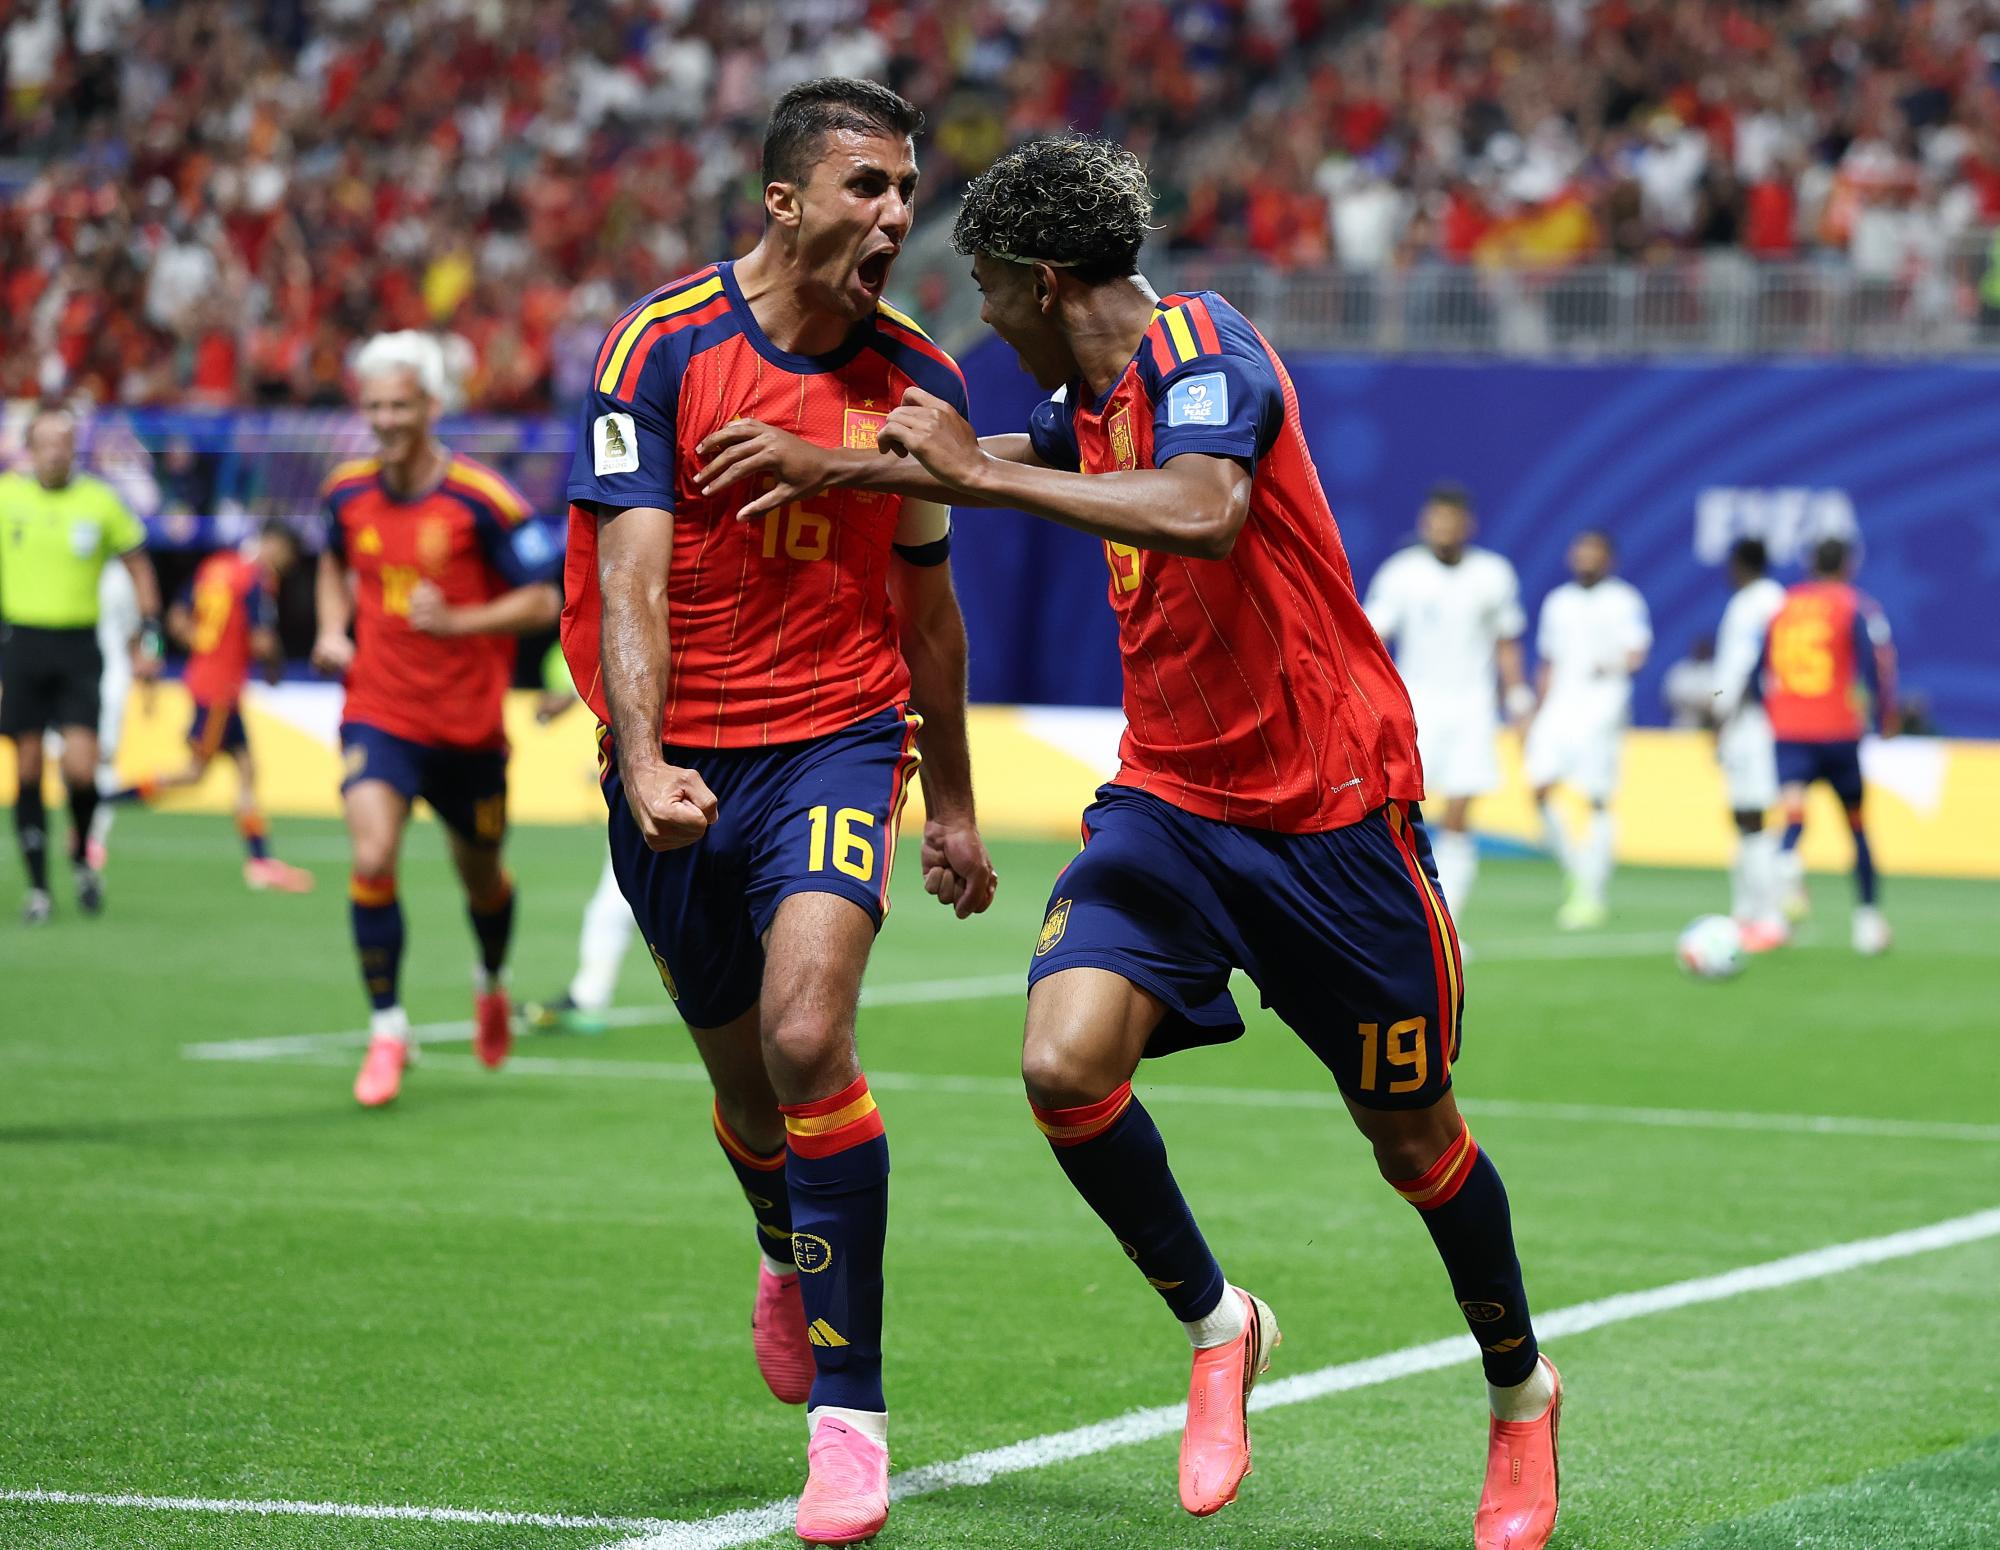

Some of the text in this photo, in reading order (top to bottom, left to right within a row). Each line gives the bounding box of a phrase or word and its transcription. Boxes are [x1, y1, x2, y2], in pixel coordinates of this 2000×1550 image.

[761, 476, 832, 561] 16
[808, 805, 875, 881] 16
[1357, 1015, 1428, 1094] 19
[795, 1240, 817, 1252] RF
[797, 1252, 818, 1264] EF
